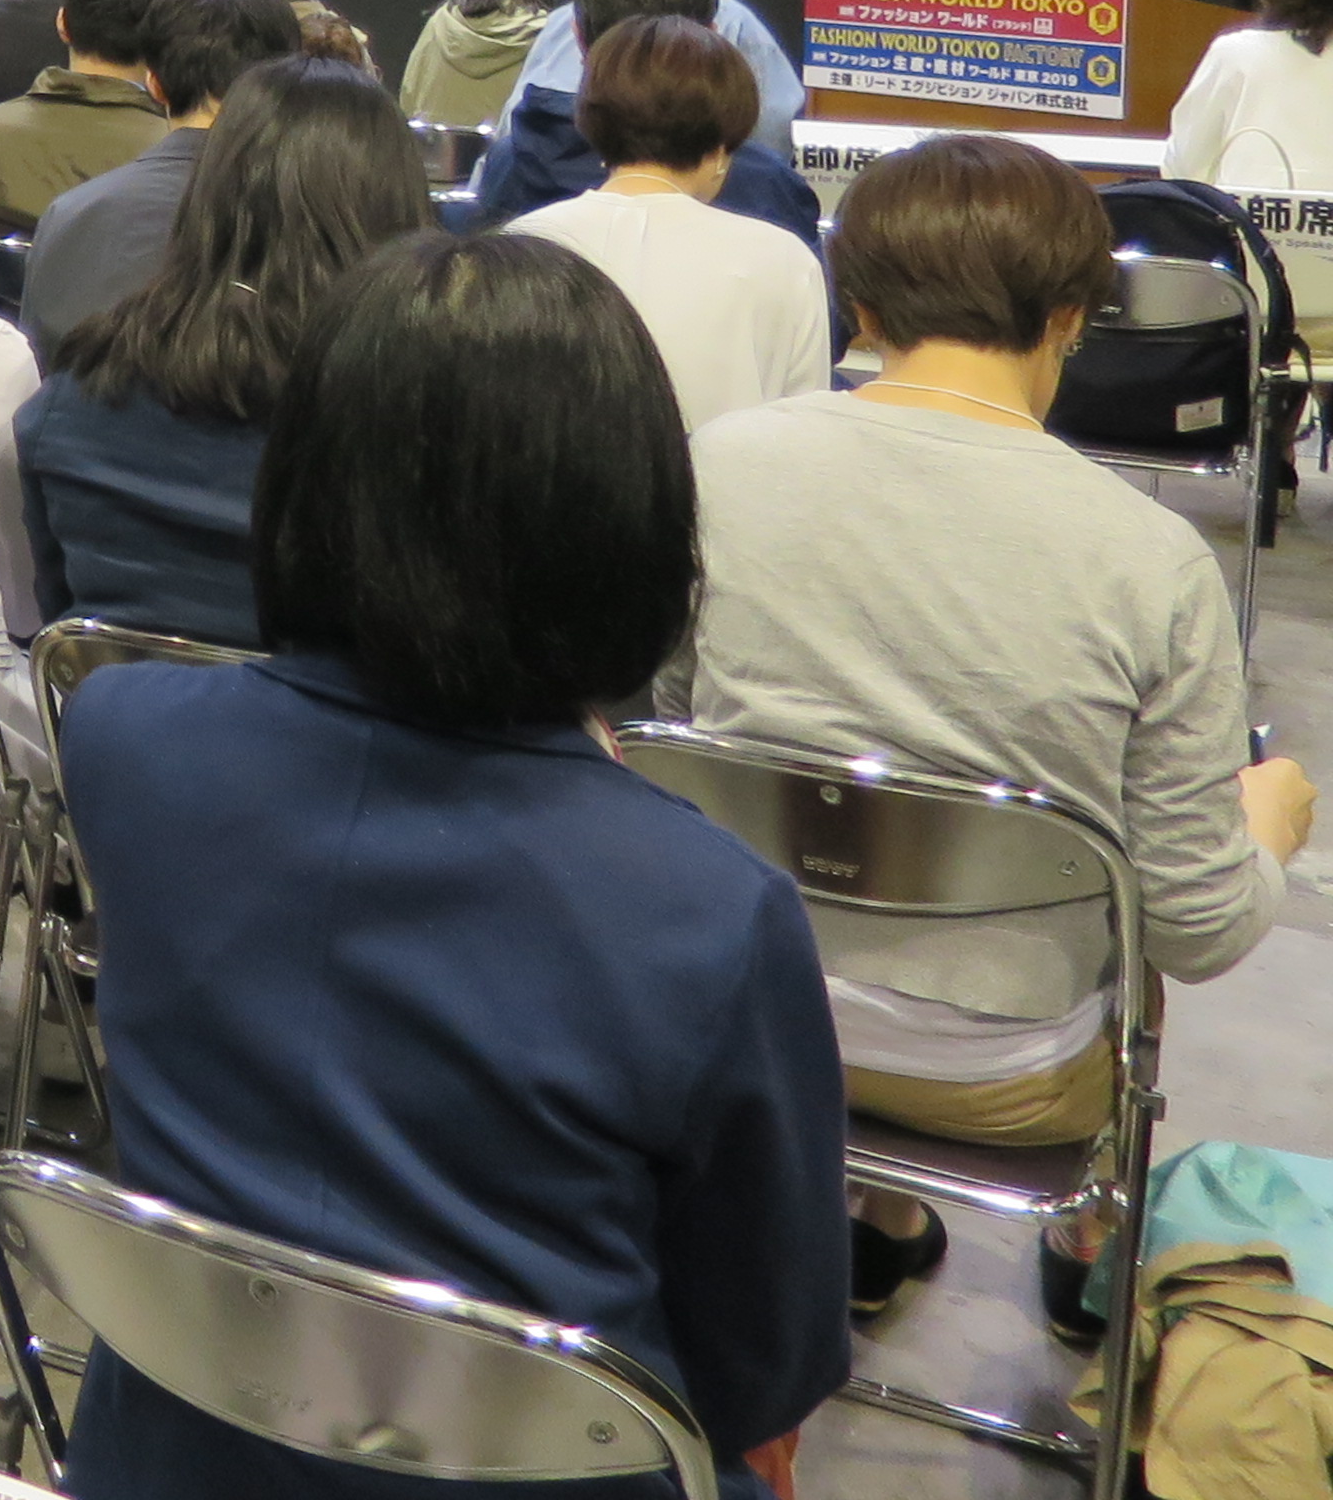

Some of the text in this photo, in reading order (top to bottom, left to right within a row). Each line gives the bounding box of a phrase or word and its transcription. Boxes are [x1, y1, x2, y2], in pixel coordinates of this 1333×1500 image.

[810, 26, 1083, 68] FASHION WORLD TOKYO FACTORY
[1042, 72, 1078, 87] 2019
[790, 144, 881, 172] 師席
[1237, 195, 1333, 236] 師席
